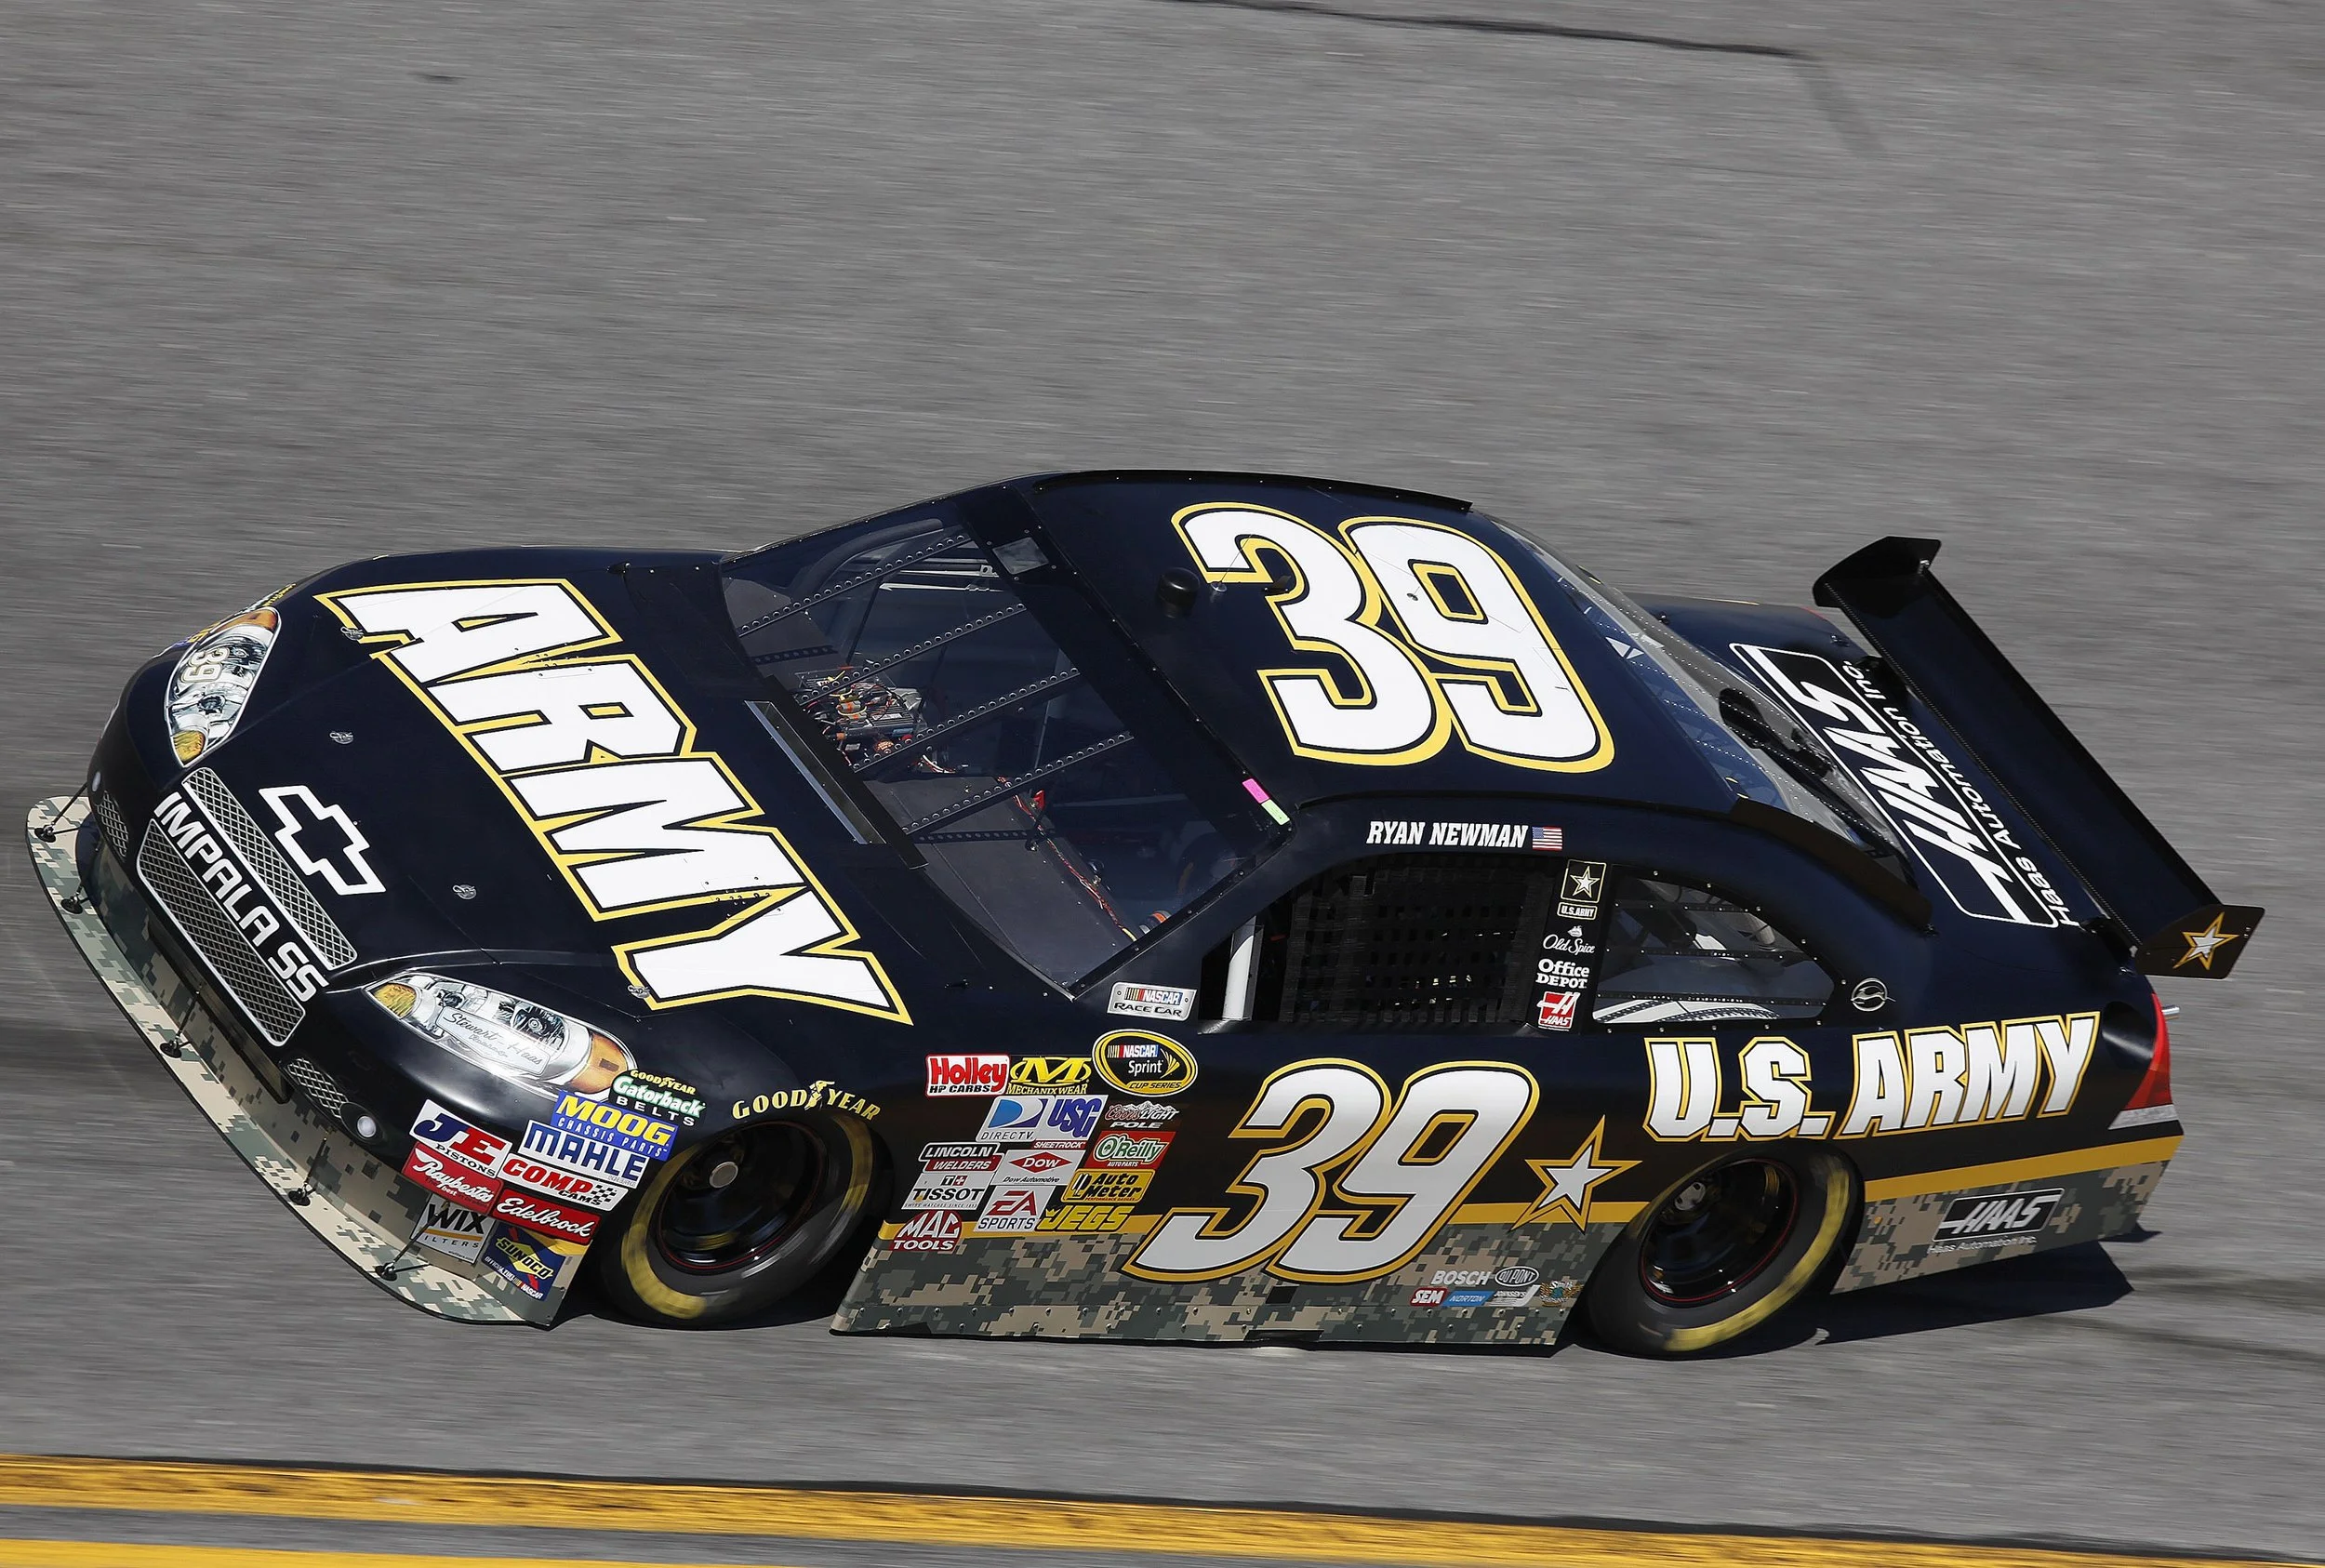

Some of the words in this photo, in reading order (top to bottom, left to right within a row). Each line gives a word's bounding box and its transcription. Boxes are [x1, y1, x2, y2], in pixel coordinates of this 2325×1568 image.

[1171, 502, 1614, 774] 39
[180, 647, 230, 683] 39
[1841, 659, 1887, 701] Inc.
[1883, 707, 2022, 851] Automation
[312, 578, 913, 1025] ARMY
[1366, 820, 1426, 844] RYAN
[1428, 822, 1529, 848] NEWMAN
[153, 791, 280, 948] IMPALA
[267, 941, 329, 1003] SS
[2017, 857, 2081, 928] Haas
[1543, 934, 1569, 951] Old
[1568, 937, 1596, 956] Spice
[1535, 972, 1588, 989] DEPOT
[1538, 958, 1590, 977] Office
[1114, 1003, 1152, 1013] RACE
[1154, 1007, 1183, 1017] CAR
[1143, 989, 1183, 1005] NASCAR
[1123, 1045, 1159, 1058] NASCAR
[930, 1057, 1007, 1092] Holley
[1128, 1060, 1161, 1077] Sprint
[1643, 1037, 1836, 1142] U.S.
[1834, 1011, 2101, 1139] ARMY
[613, 1075, 706, 1118] Gatorback
[1005, 1083, 1057, 1095] MECHANIX
[1058, 1083, 1088, 1095] WEAR
[556, 1095, 675, 1147] MOOG
[616, 1096, 696, 1127] BELTS
[1046, 1097, 1103, 1138] USG
[1105, 1104, 1140, 1121] Coors
[414, 1112, 507, 1166] JE
[558, 1117, 615, 1142] CHASSIS
[622, 1136, 662, 1157] PARTS
[981, 1131, 1032, 1140] DIRECTV
[1097, 1135, 1164, 1163] O'Reilly
[435, 1144, 496, 1177] PISTONS
[524, 1123, 646, 1181] MAHLE
[924, 1146, 993, 1158] LINCOLN
[933, 1161, 991, 1170] WELDERS
[412, 1147, 494, 1203] Raybestos
[503, 1159, 594, 1195] COMP
[1092, 1173, 1139, 1186] Auto
[1121, 1056, 1540, 1283] 39
[442, 1185, 458, 1197] best
[558, 1189, 603, 1207] CAMS
[912, 1188, 985, 1201] TISSOT
[986, 1190, 1037, 1216] EA
[1086, 1185, 1143, 1198] Meter
[428, 1203, 487, 1235] WIX
[497, 1198, 594, 1237] Edelbrock
[897, 1210, 961, 1239] MAC
[978, 1218, 1033, 1229] SPORTS
[1036, 1204, 1135, 1230] JEGS
[423, 1234, 480, 1249] ILTERS
[894, 1240, 954, 1251] TOOLS
[498, 1238, 551, 1279] SUNOCO
[1430, 1270, 1492, 1285] BOSCH
[521, 1283, 544, 1300] NASCAR
[1412, 1290, 1445, 1304] SEM
[1449, 1295, 1485, 1303] NORTON
